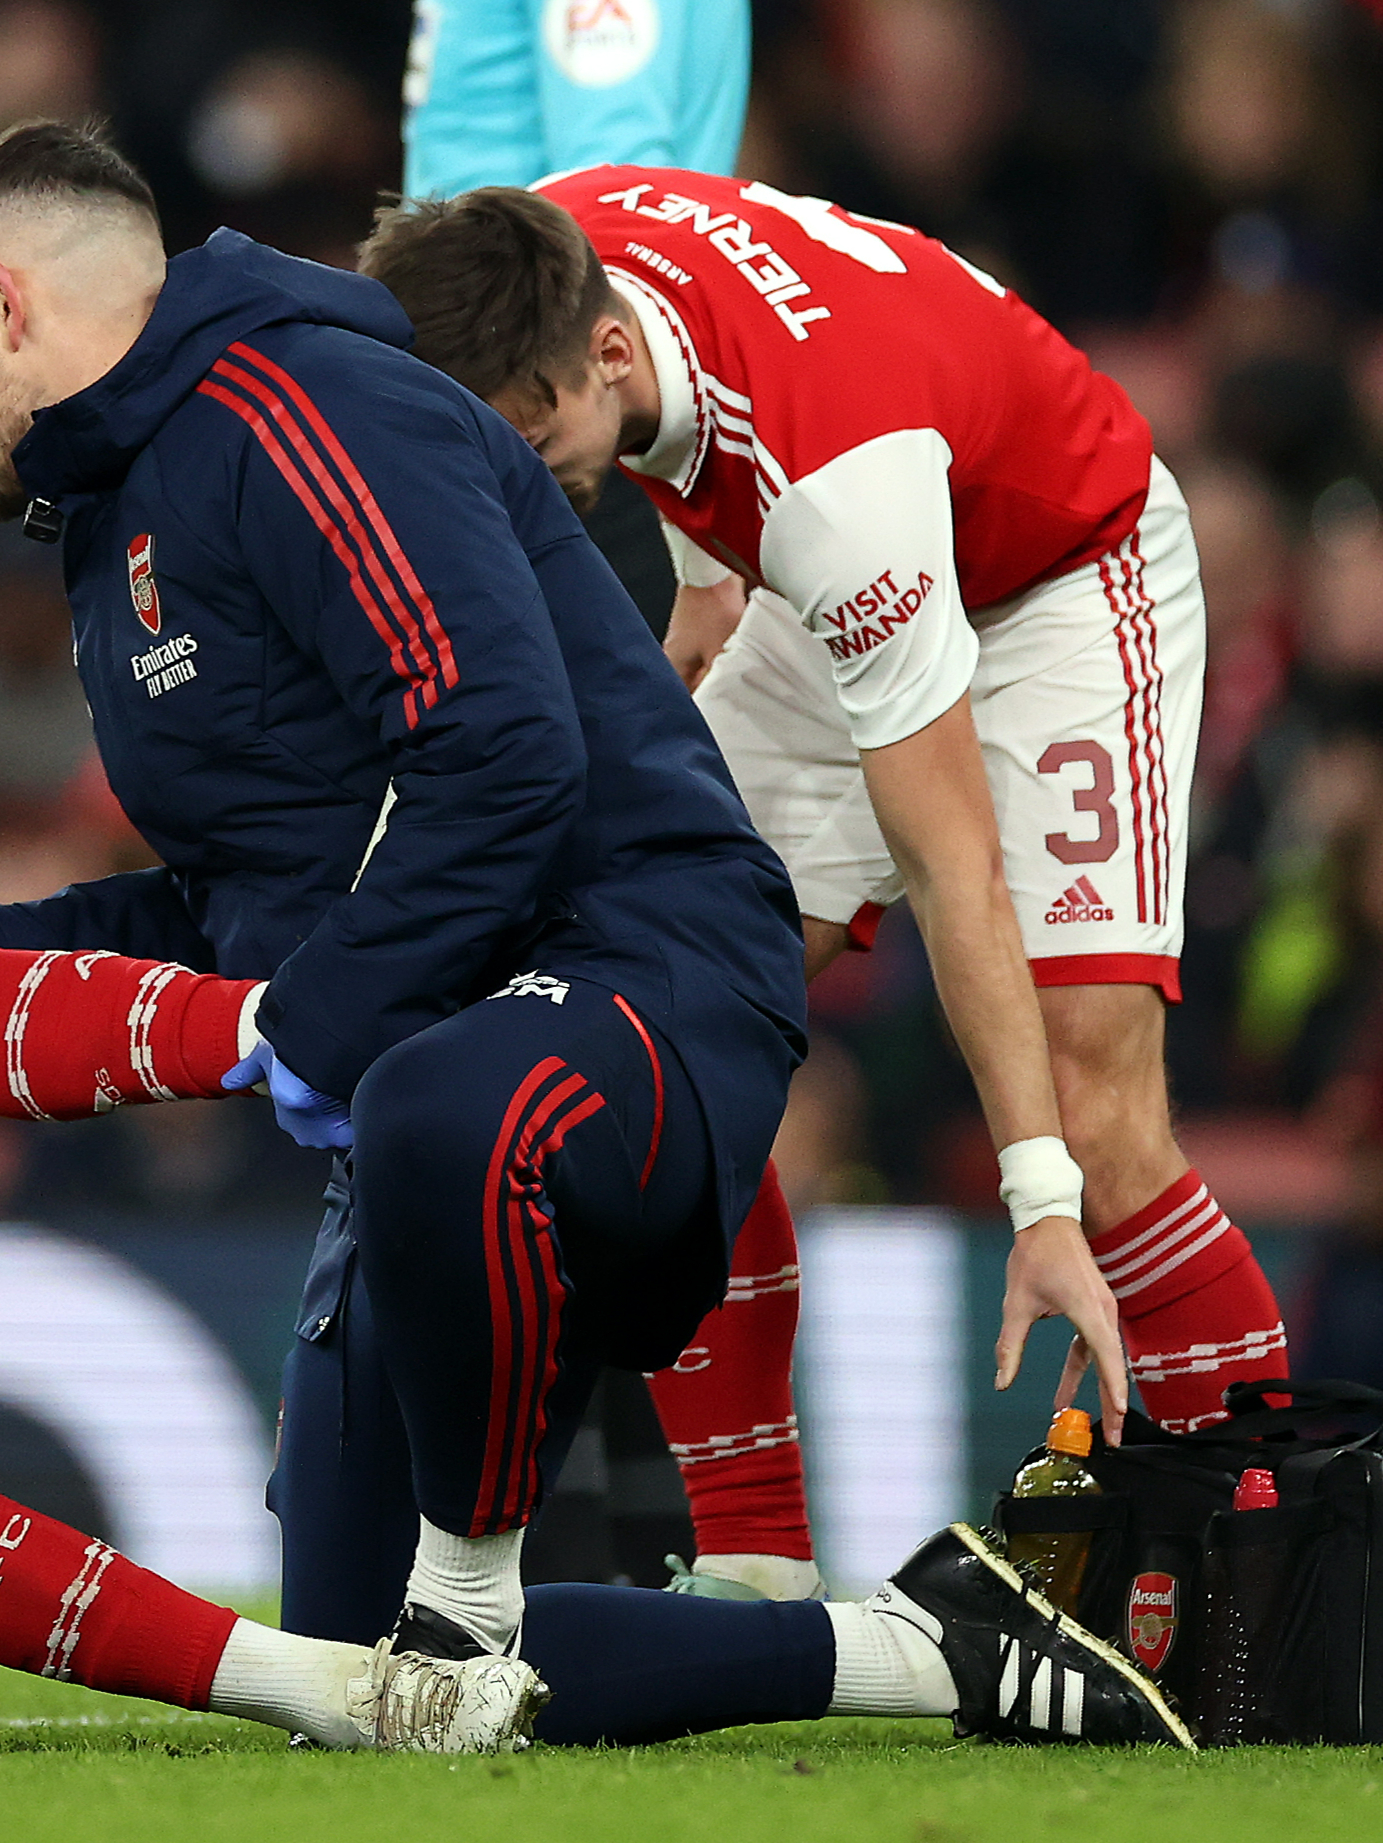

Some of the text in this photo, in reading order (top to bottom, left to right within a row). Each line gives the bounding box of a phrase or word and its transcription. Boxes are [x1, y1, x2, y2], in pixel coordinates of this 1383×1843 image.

[597, 183, 832, 342] TIERNEY
[624, 241, 694, 286] ARSENAL
[822, 569, 899, 632] VISIT
[130, 633, 198, 681] Emirates
[145, 658, 198, 699] FLY BETTER
[1036, 739, 1120, 865] 3
[1044, 904, 1116, 925] adidas
[1132, 1588, 1172, 1606] Arsenal
